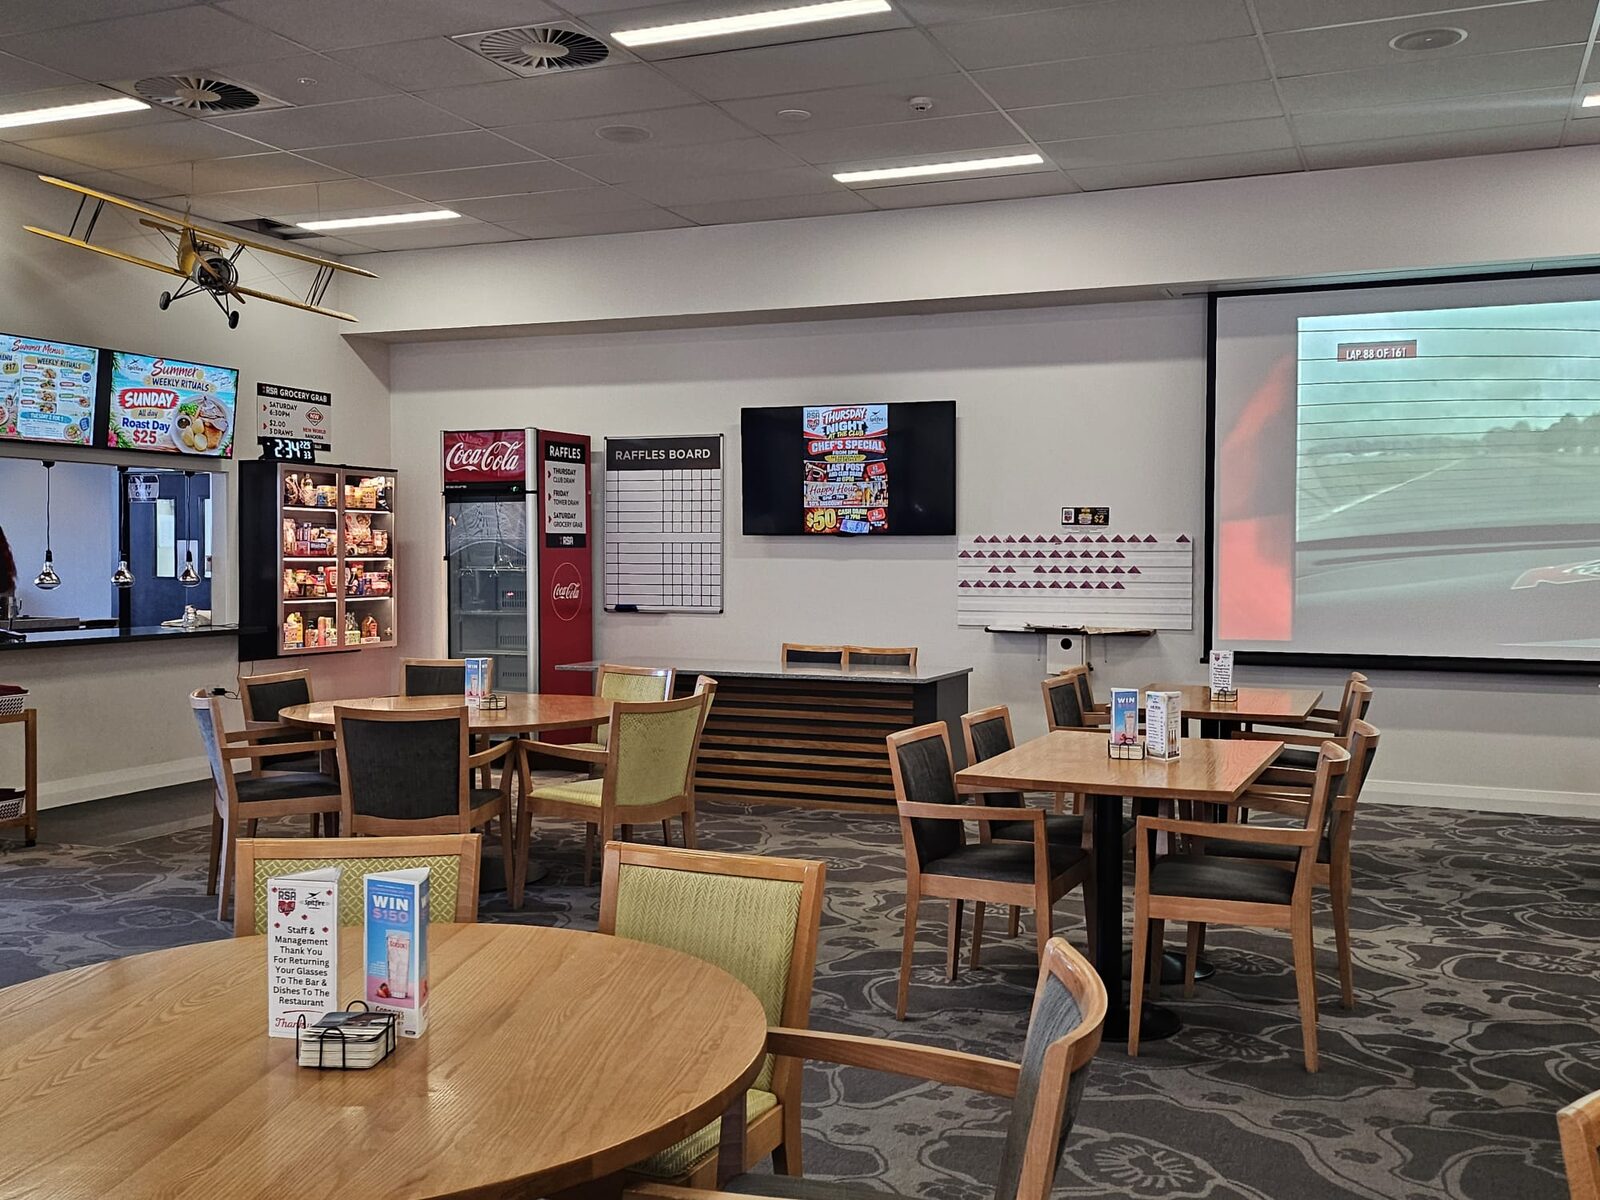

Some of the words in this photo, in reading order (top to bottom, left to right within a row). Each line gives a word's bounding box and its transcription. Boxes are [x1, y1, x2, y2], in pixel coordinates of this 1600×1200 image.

[12, 339, 41, 352] Summer
[1346, 350, 1361, 360] LAP
[1363, 349, 1374, 359] 88
[1376, 348, 1389, 358] OF
[1392, 347, 1407, 358] 161
[6, 362, 16, 370] $17
[37, 358, 58, 366] WEEKLY
[60, 360, 82, 370] RITUALS
[151, 359, 198, 378] Summer
[152, 377, 180, 388] WEEKLY
[181, 380, 210, 392] RITUALS
[124, 392, 174, 408] SUNDAY
[280, 388, 310, 400] GROCERY
[311, 394, 328, 402] GRAB
[270, 402, 298, 411] SATURDAY
[138, 409, 147, 417] All
[148, 411, 158, 422] day
[822, 407, 866, 424] THURSDAY
[122, 417, 150, 430] Roast
[152, 420, 171, 434] Day
[270, 420, 286, 428] $2.00
[826, 420, 864, 435] NIGHT
[132, 430, 157, 444] $25
[274, 428, 294, 437] DRAWS
[274, 439, 300, 458] 2:34
[550, 444, 581, 460] RAFFLES
[812, 440, 844, 452] CHEF'S
[846, 440, 883, 450] SPECIAL
[446, 441, 524, 472] Coca-Cola
[615, 450, 666, 460] RAFFLES
[669, 448, 711, 460] BOARD
[553, 468, 576, 476] THURSDAY
[827, 463, 844, 472] LAST
[846, 464, 866, 472] POST
[809, 485, 834, 496] Happy
[836, 484, 857, 494] Hour
[806, 508, 836, 530] $50
[1094, 515, 1104, 524] $2
[278, 891, 296, 900] RSA
[372, 894, 409, 912] WIN
[372, 908, 409, 924] $150
[288, 926, 307, 934] Staff
[275, 936, 328, 946] Management
[280, 946, 304, 954] Thank
[306, 948, 322, 956] You
[289, 956, 330, 968] Returning
[276, 966, 294, 974] Your
[296, 968, 328, 976] Glasses
[276, 976, 286, 984] To
[288, 976, 304, 985] The
[306, 978, 320, 986] Bar
[274, 986, 300, 995] Dishes
[302, 988, 312, 996] To
[314, 989, 330, 998] The
[279, 996, 324, 1007] Restaurant
